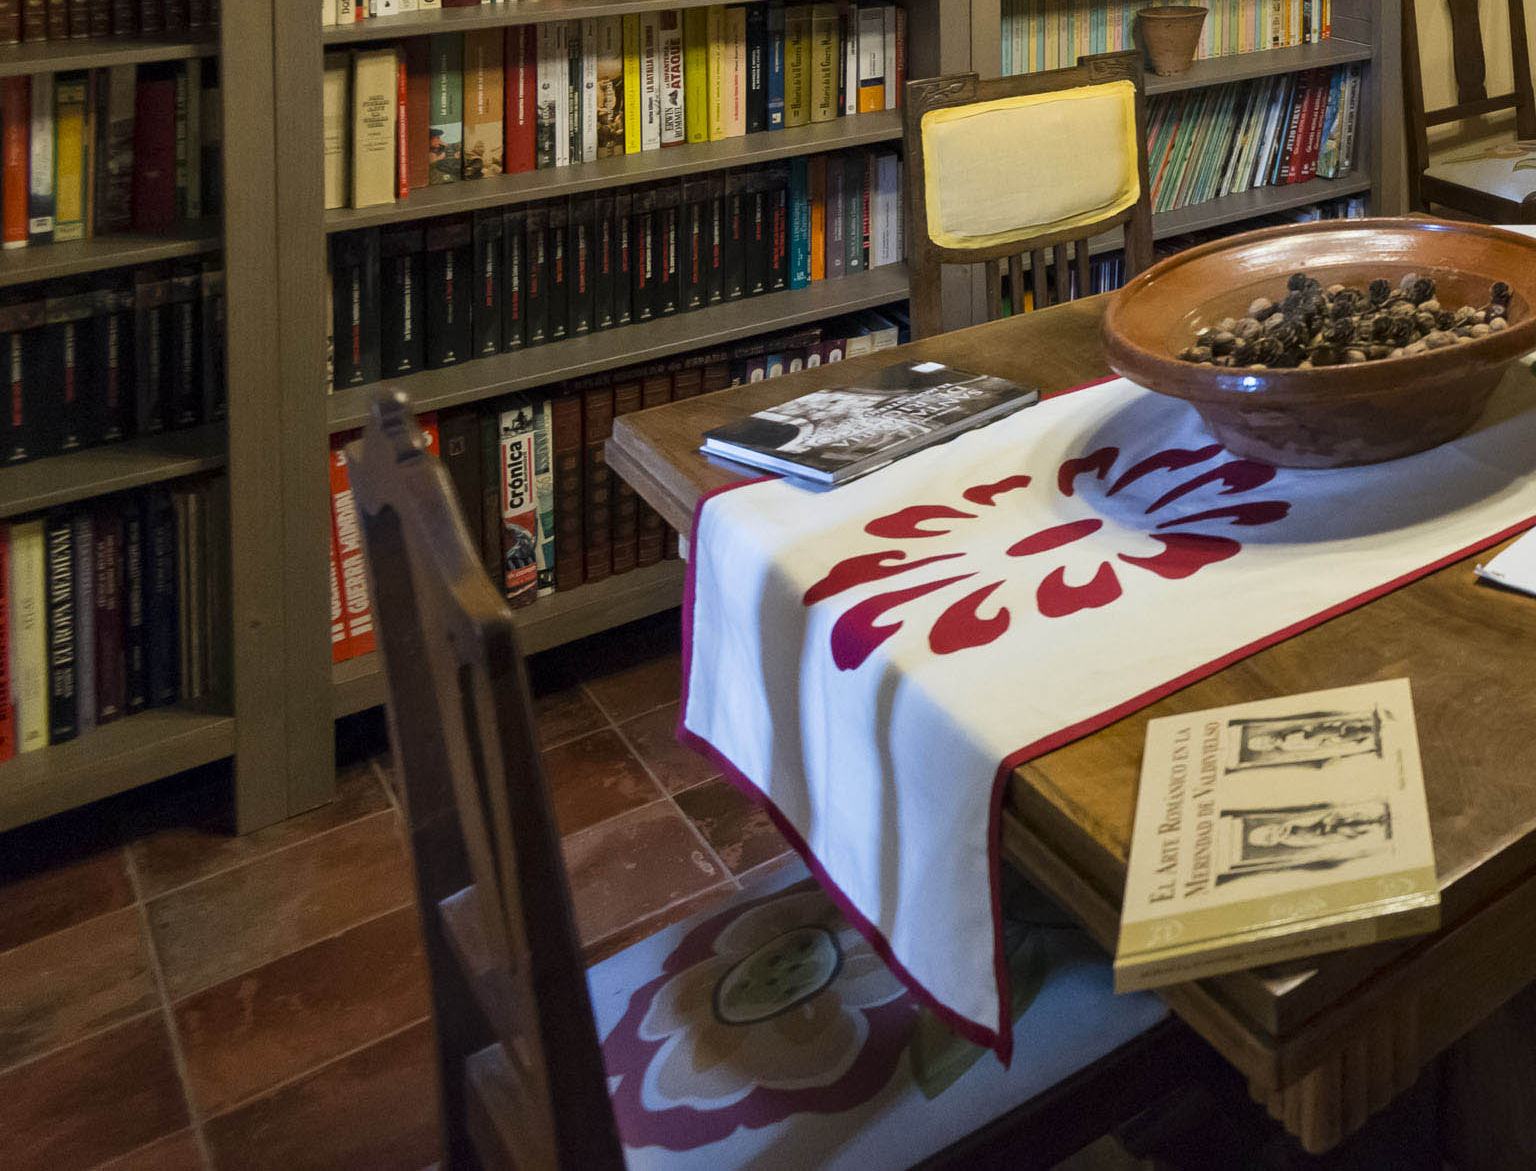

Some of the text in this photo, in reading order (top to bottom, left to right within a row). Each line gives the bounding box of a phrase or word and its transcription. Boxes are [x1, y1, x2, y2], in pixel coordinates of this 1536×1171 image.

[646, 59, 655, 84] BATALLA
[671, 37, 681, 89] ATAQUE
[665, 107, 674, 131] ERWIN
[674, 106, 682, 138] ROMMEL
[1286, 103, 1301, 152] JULIO VERNE
[909, 387, 984, 420] SANTA
[931, 384, 968, 400] DE
[507, 440, 524, 509] Crónica
[341, 554, 370, 615] GUERRA
[51, 603, 75, 667] EUROPA
[1148, 727, 1191, 903] EL ARTE ROMÁNICO EN LA
[1184, 720, 1220, 897] MERINDAD DE VALDIVIELSO
